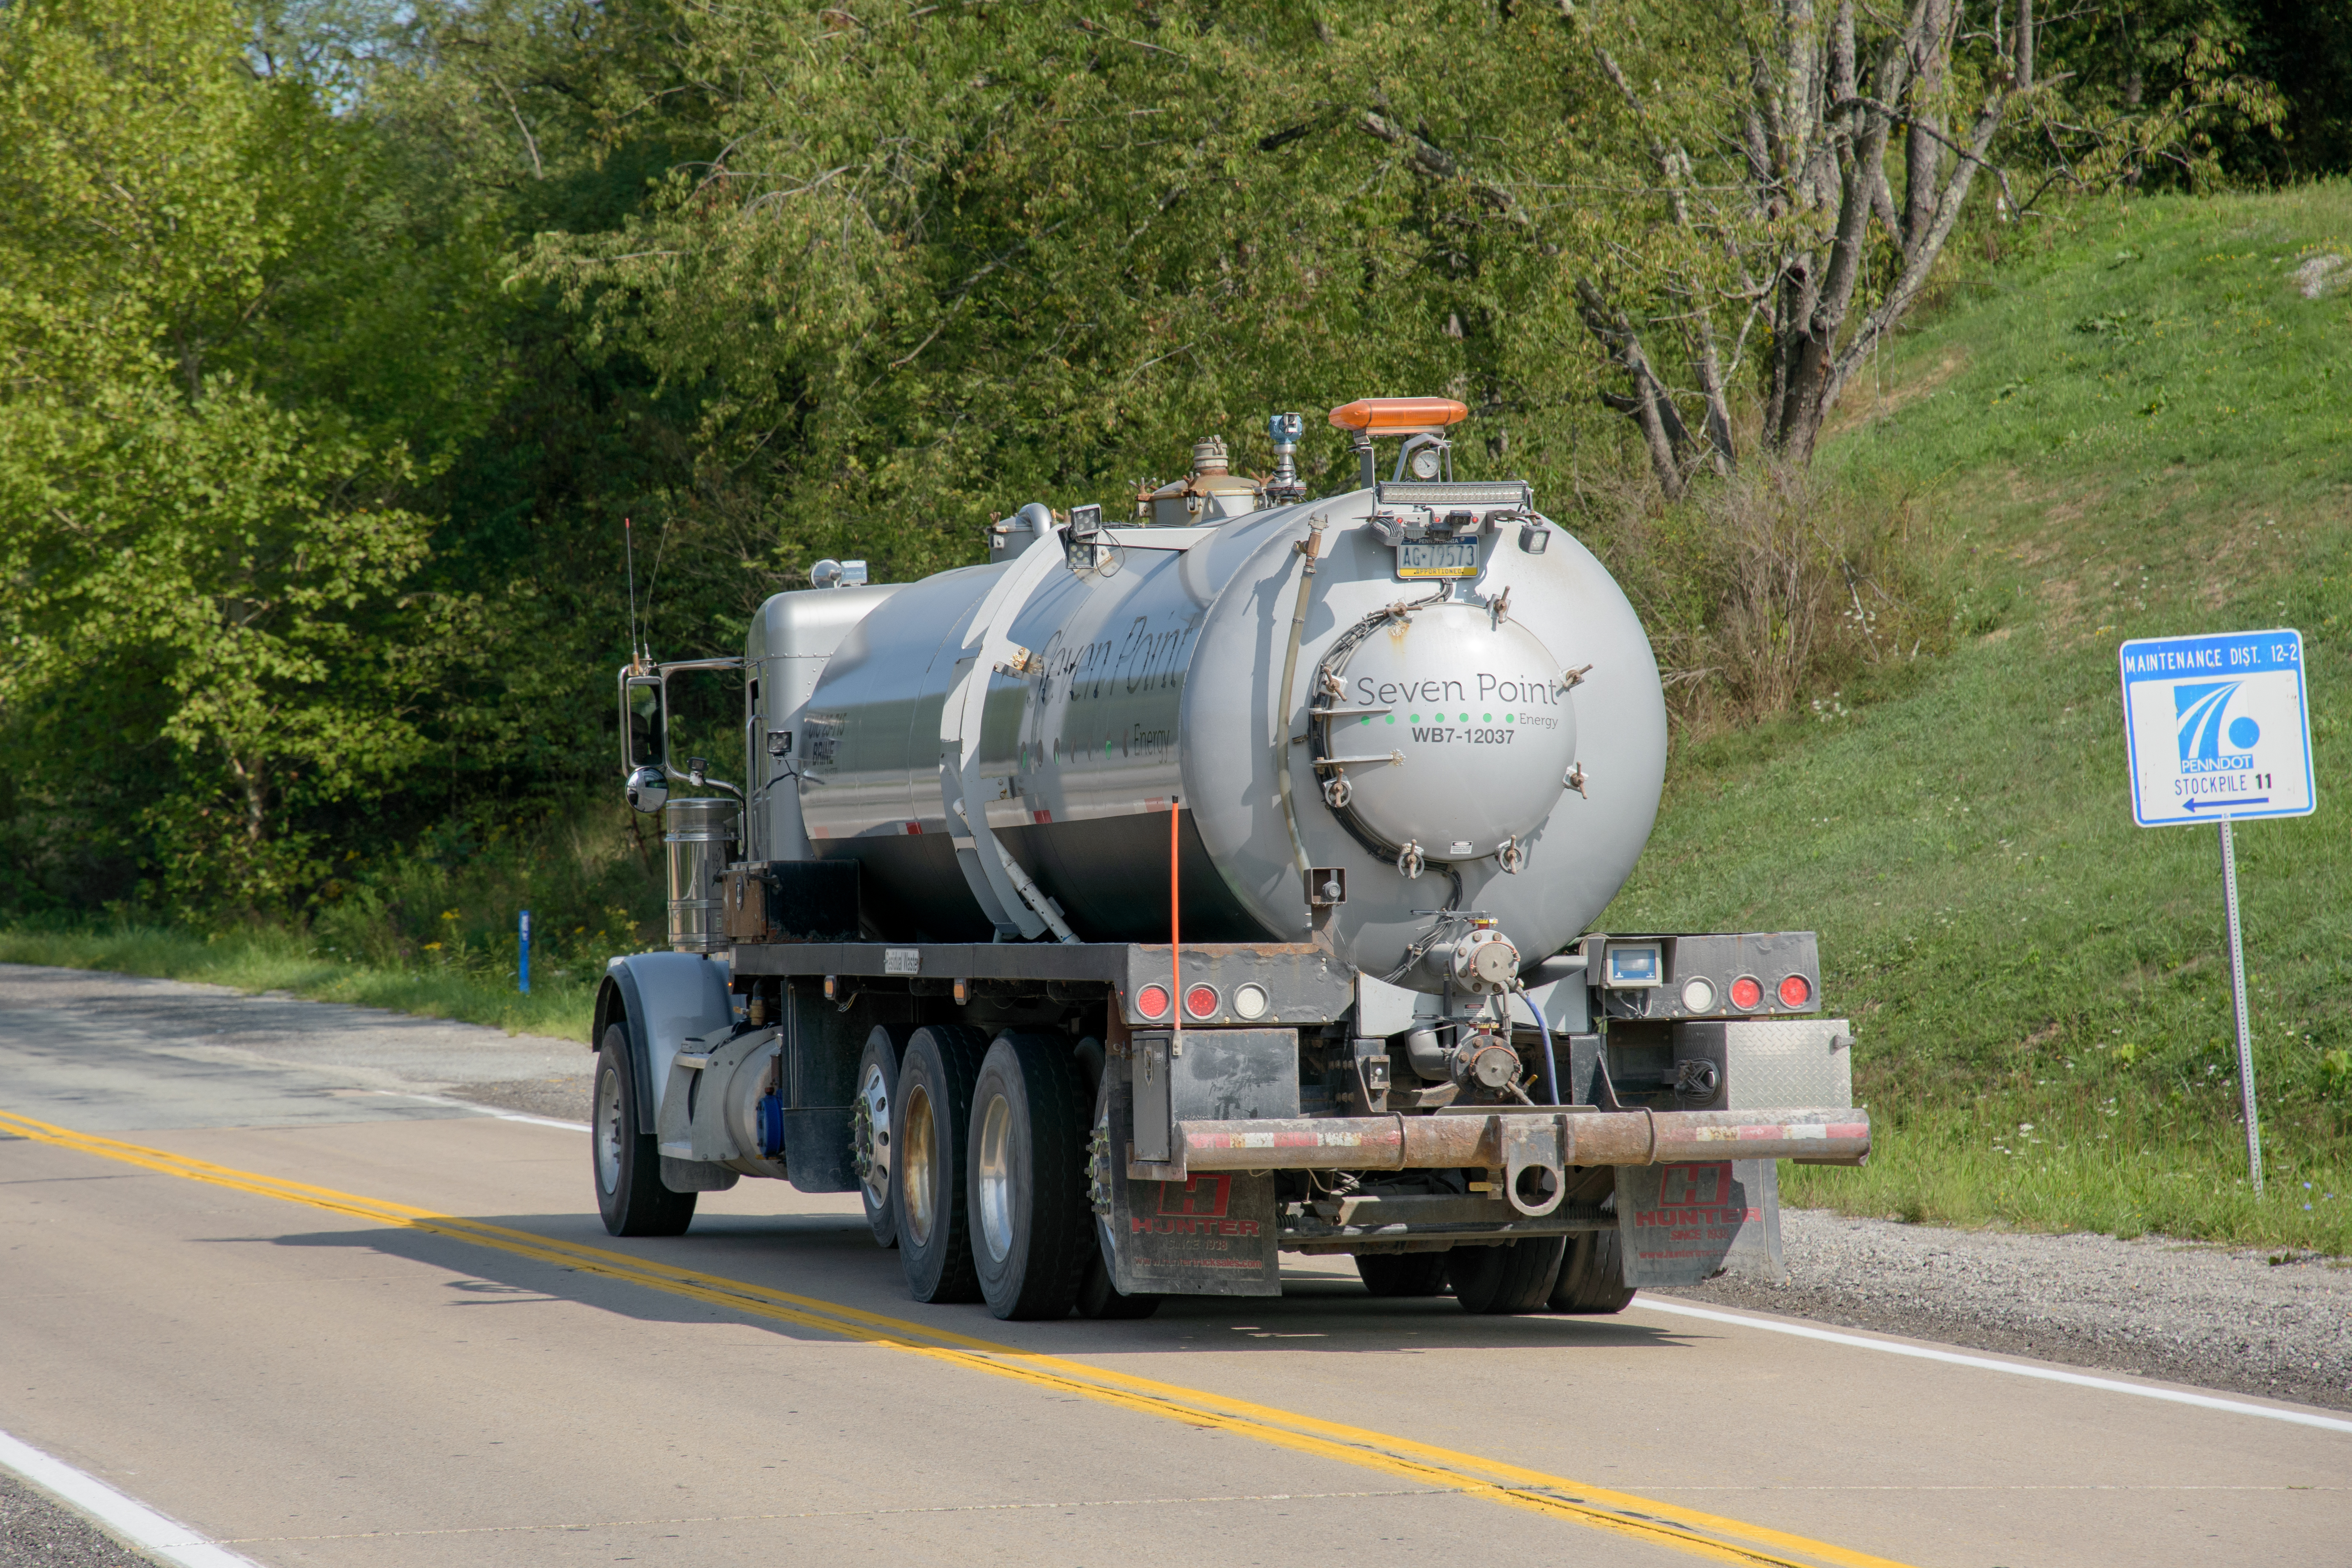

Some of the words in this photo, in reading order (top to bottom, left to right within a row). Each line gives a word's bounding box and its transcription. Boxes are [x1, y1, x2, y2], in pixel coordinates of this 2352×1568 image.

[1428, 546, 1474, 566] 79573
[1110, 611, 1196, 694] Point
[2126, 649, 2222, 673] MAINTENANCE
[2230, 646, 2261, 665] DIST.
[2271, 644, 2298, 662] 12-2
[1357, 677, 1465, 706] Seven
[1477, 673, 1558, 705] Point
[1519, 713, 1559, 729] Energy
[1134, 723, 1170, 764] Energy
[1412, 728, 1515, 744] WB7-12037
[812, 741, 835, 766] BRINE
[2182, 755, 2252, 773] PENNDOT
[2175, 775, 2248, 795] STOCKPILE
[2255, 773, 2272, 790] 11
[886, 951, 903, 971] Residual
[903, 952, 917, 972] Waste
[1635, 1207, 1762, 1226] HUNTER
[1132, 1218, 1259, 1236] HUNTER
[1670, 1230, 1701, 1241] SINCE
[1206, 1239, 1228, 1250] 1938
